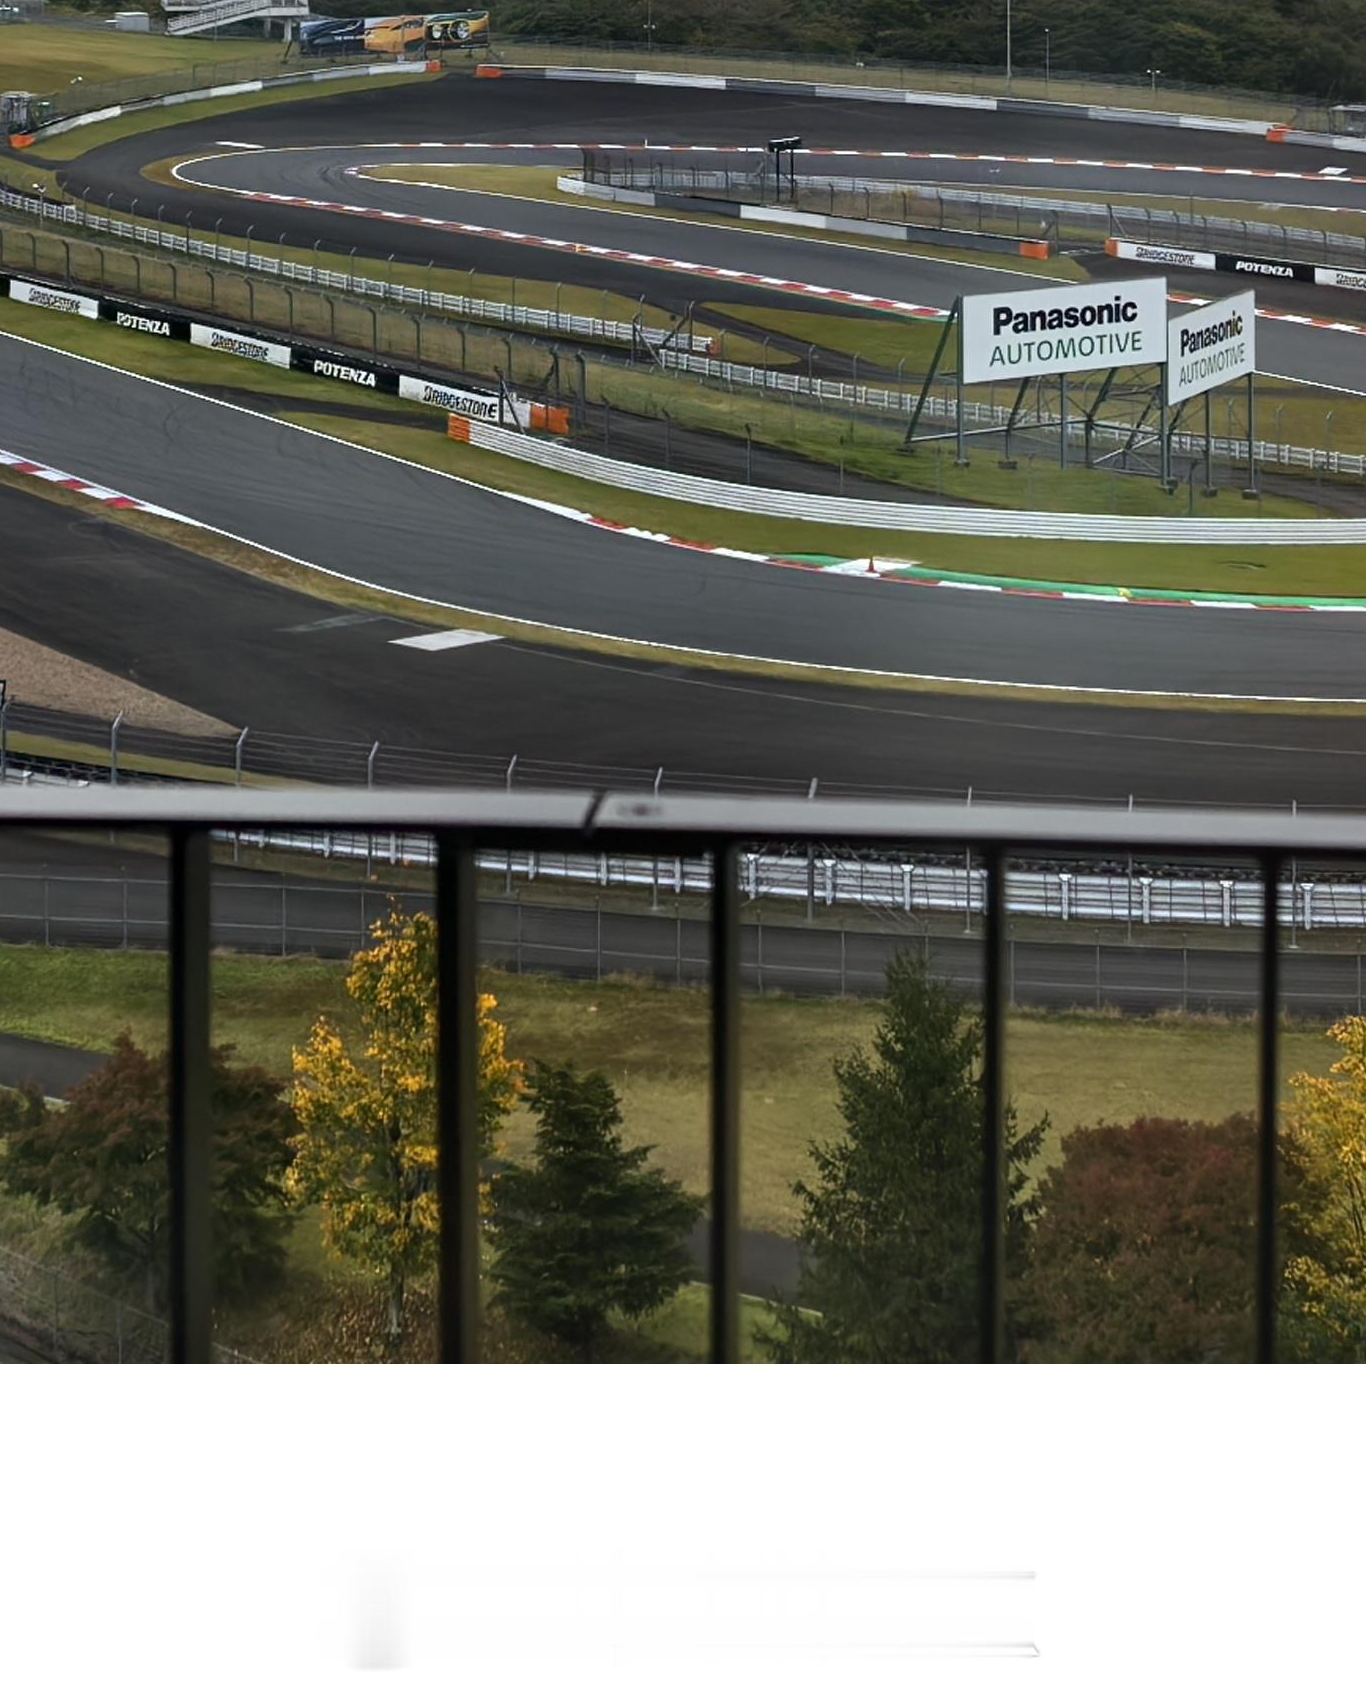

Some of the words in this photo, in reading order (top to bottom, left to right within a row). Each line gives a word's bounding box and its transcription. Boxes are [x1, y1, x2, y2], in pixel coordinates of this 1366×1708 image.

[1236, 260, 1294, 279] POTENZA
[116, 312, 170, 336] POTENZA
[993, 296, 1138, 335] Panasonic
[989, 330, 1143, 367] AUTOMOTIVE
[1180, 310, 1243, 357] Panasonic
[314, 359, 377, 388] POTENZA
[1179, 343, 1245, 387] AUTOMOTIVE
[423, 385, 498, 418] BRIDGESTONE
